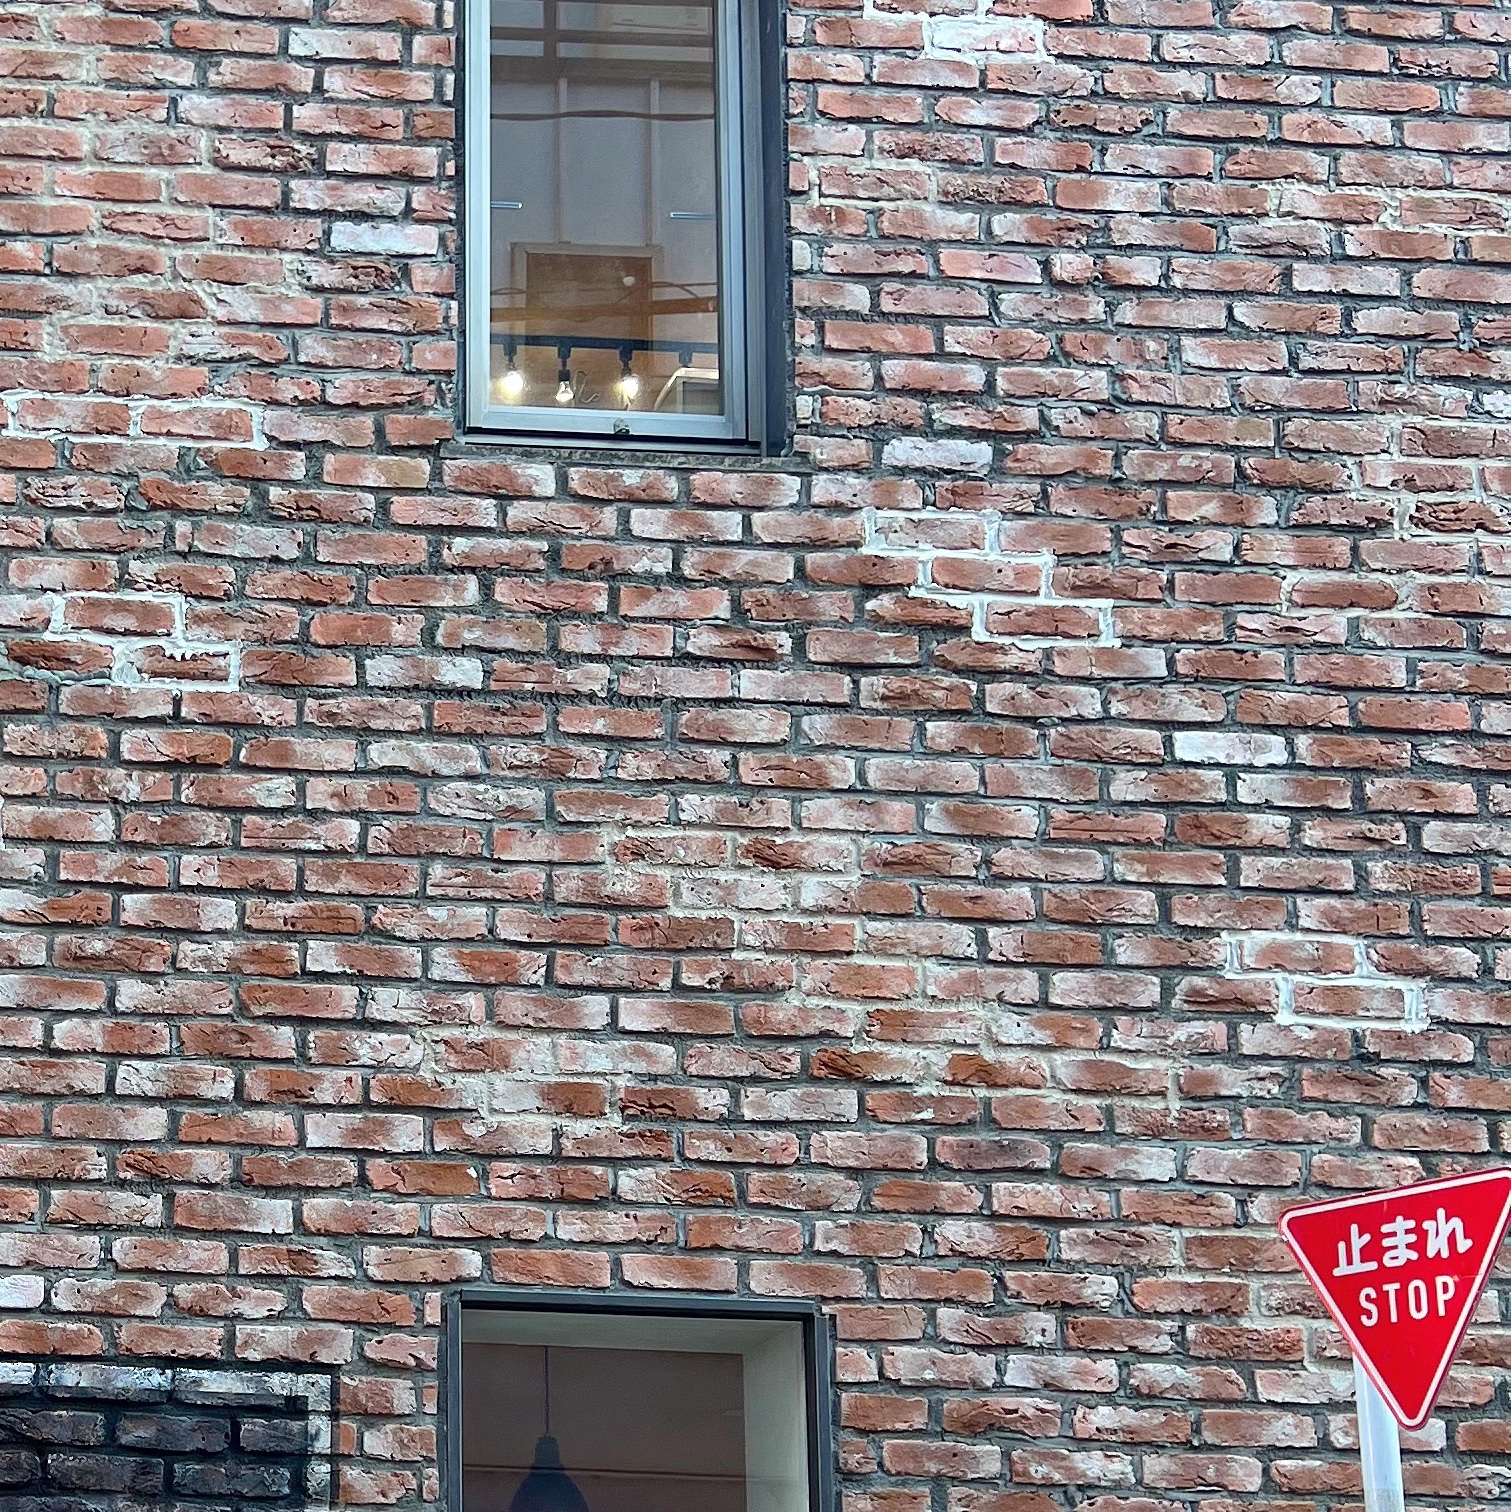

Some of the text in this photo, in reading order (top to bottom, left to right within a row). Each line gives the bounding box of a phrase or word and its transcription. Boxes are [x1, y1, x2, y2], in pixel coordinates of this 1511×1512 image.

[1332, 1207, 1473, 1277] 止まれ
[1359, 1274, 1456, 1327] STOP
